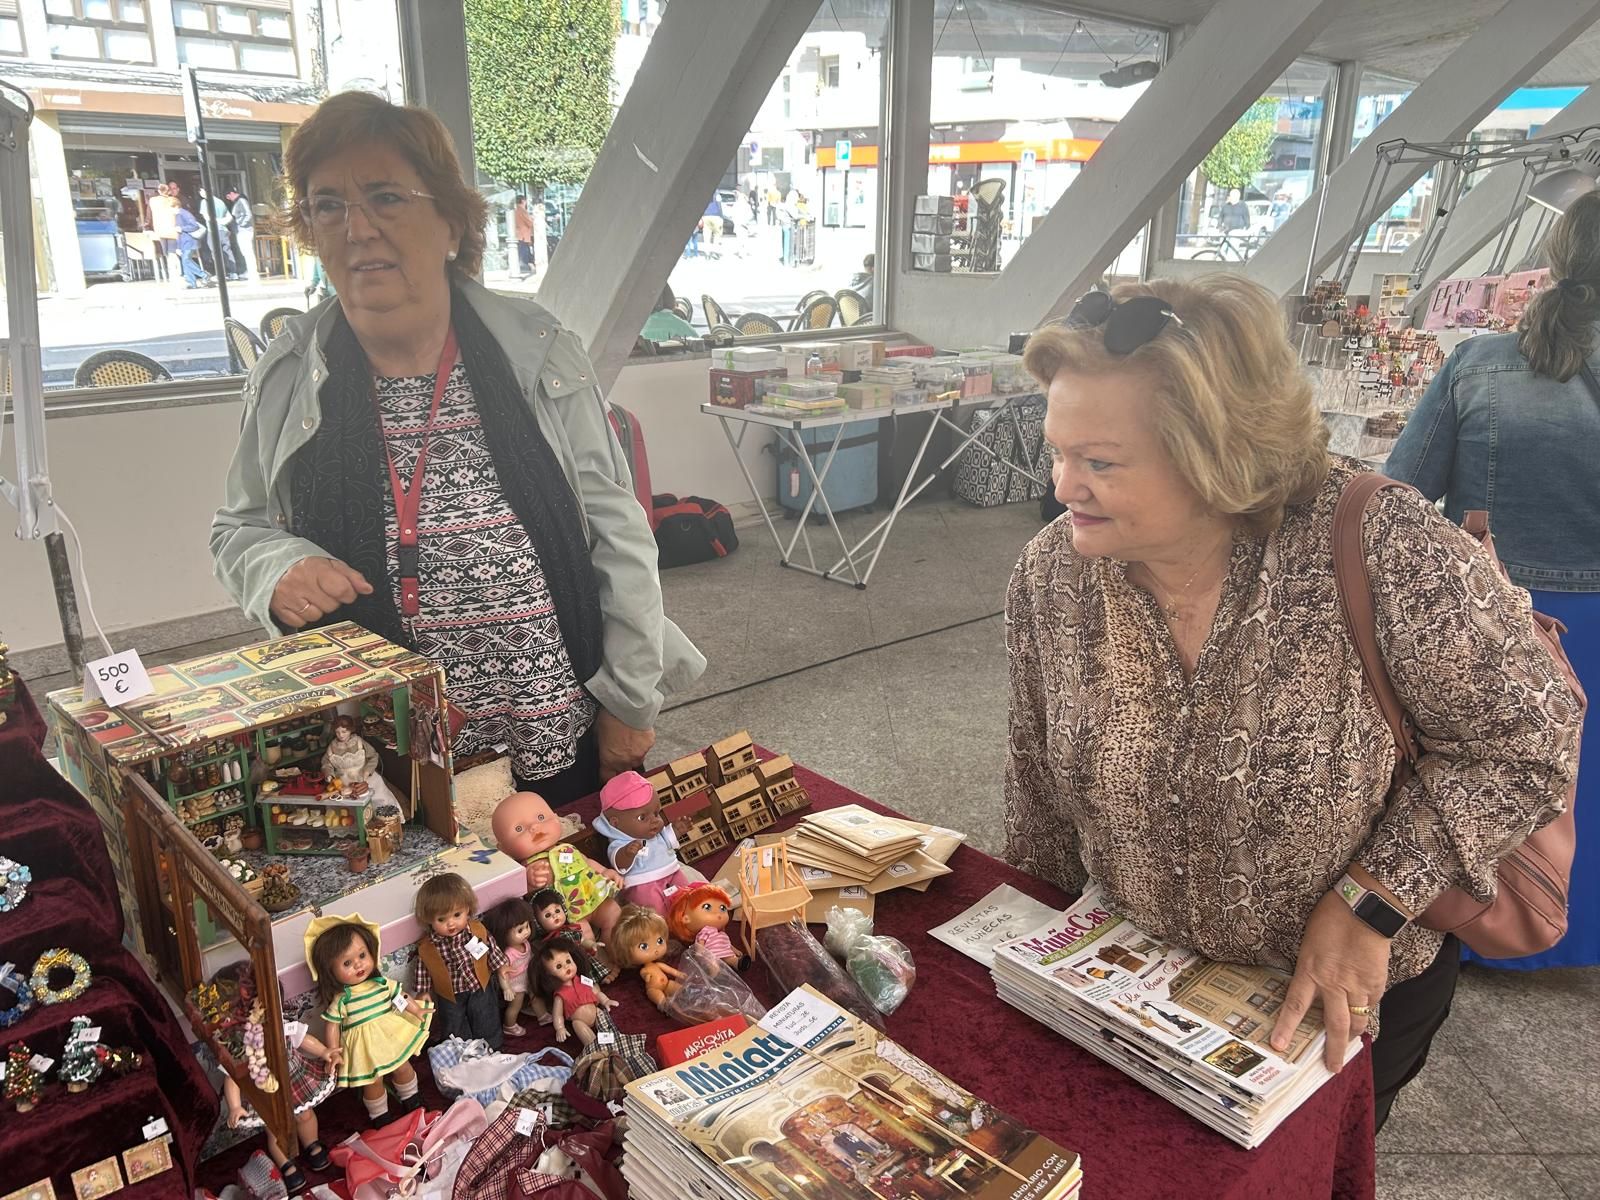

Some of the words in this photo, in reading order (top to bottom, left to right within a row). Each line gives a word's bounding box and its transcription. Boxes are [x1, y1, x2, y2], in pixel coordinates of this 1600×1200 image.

[98, 662, 130, 682] 500
[114, 679, 129, 694] €
[947, 904, 999, 937] REVISTAS
[768, 1001, 791, 1020] REVISTA
[773, 1001, 805, 1029] MINIATURAS
[675, 1033, 797, 1096] Miniatu
[1010, 1169, 1043, 1200] LENDARIO
[1042, 1153, 1059, 1169] CON
[1033, 1178, 1048, 1194] MES
[1052, 1158, 1068, 1174] MES
